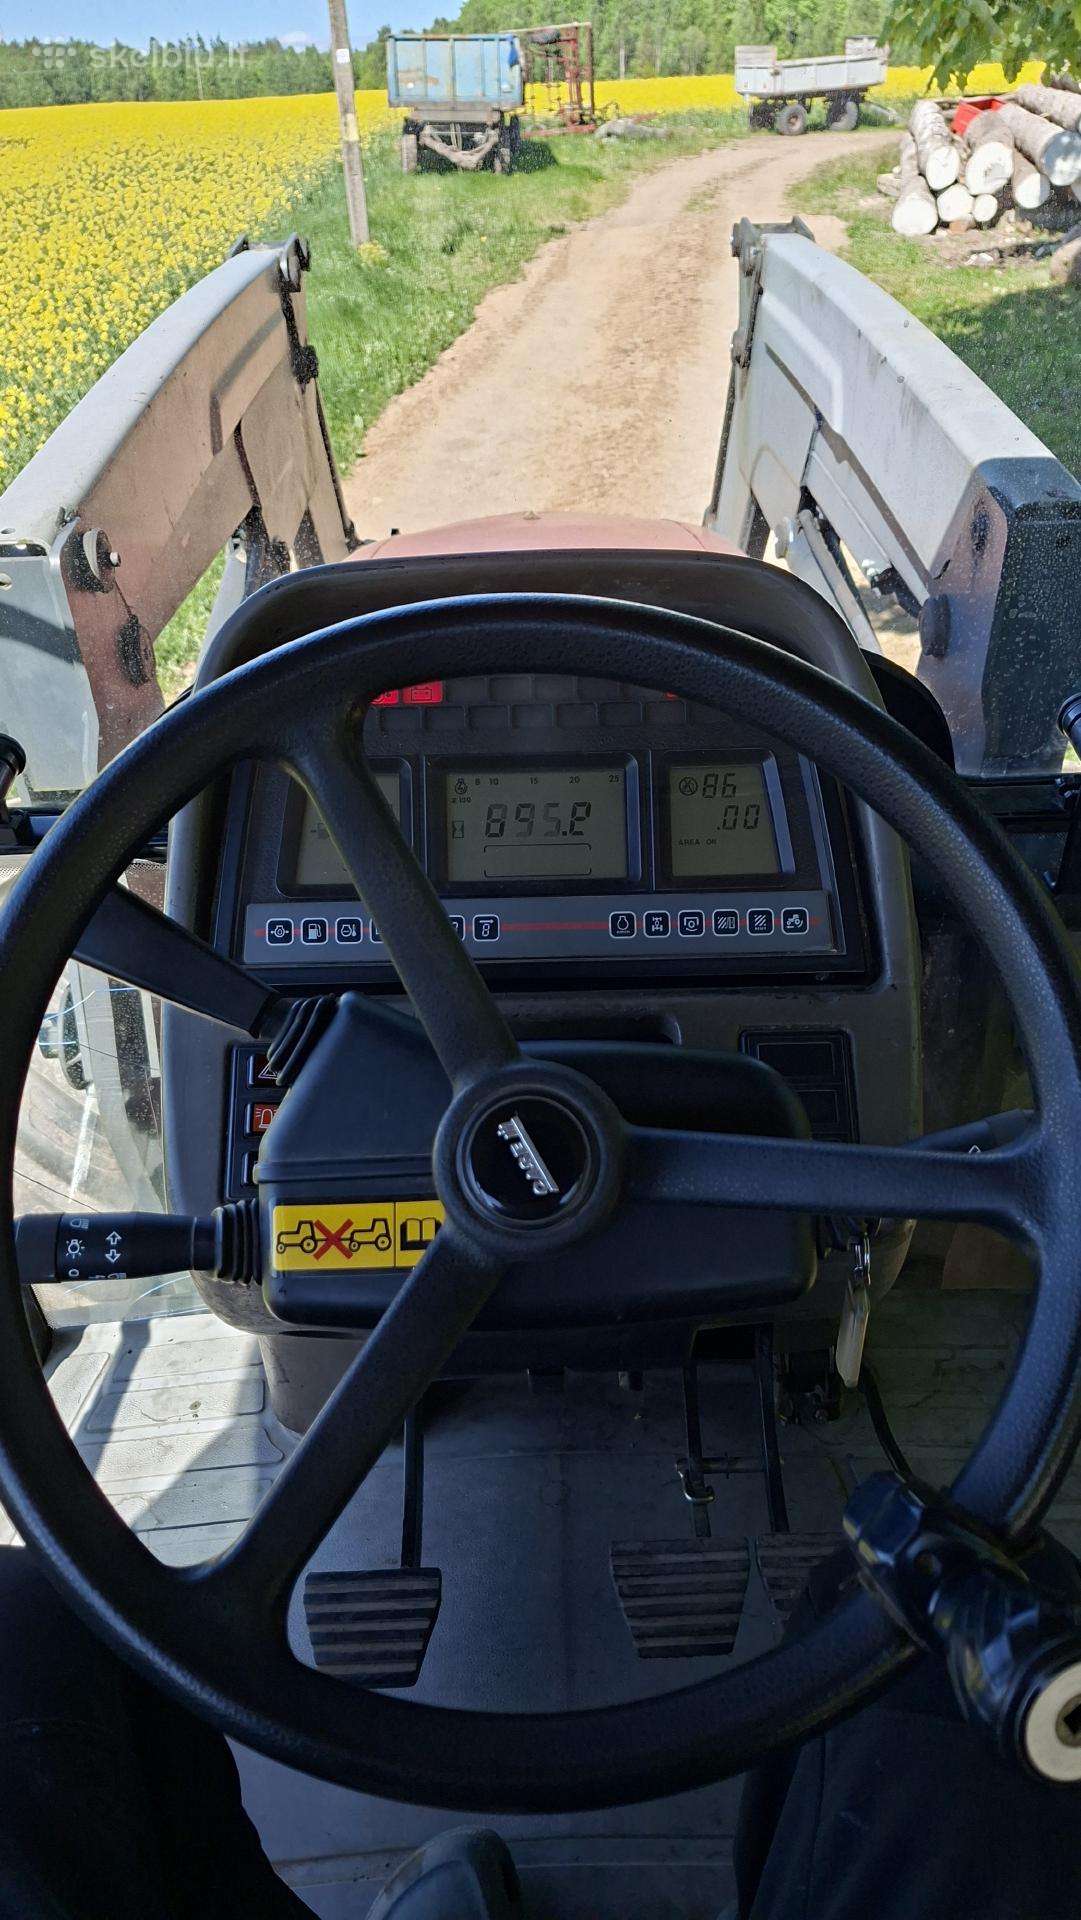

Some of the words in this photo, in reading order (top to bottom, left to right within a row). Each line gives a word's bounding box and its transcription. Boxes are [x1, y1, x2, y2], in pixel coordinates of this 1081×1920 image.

[489, 778, 499, 786] 10
[530, 777, 538, 785] 15
[569, 776, 580, 784] 20
[608, 775, 619, 783] 25
[702, 773, 737, 799] 86
